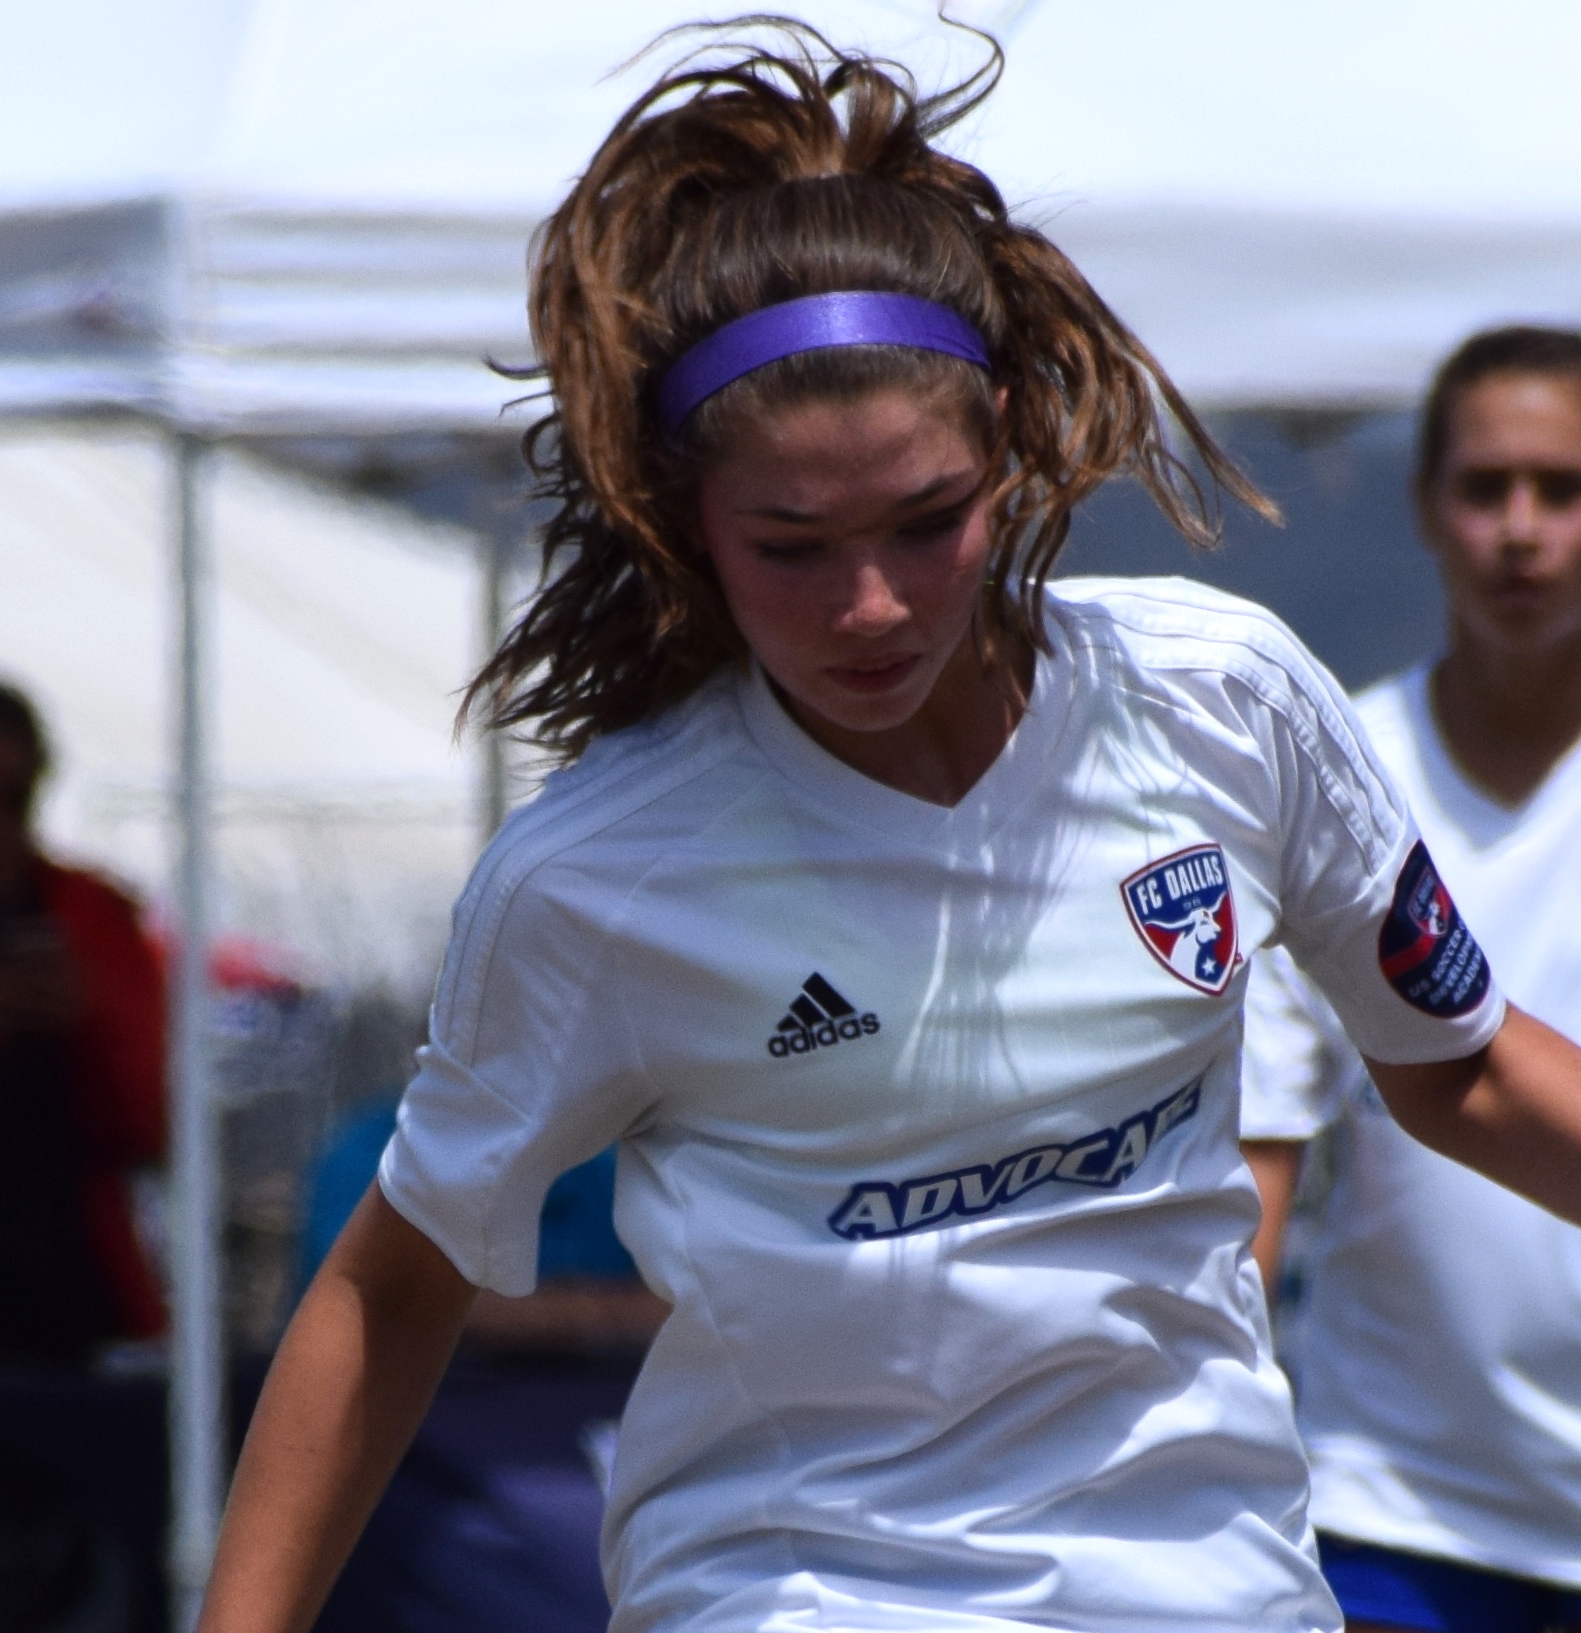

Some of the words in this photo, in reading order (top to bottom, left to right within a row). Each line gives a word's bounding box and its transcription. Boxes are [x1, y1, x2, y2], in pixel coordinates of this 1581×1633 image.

[1136, 877, 1163, 915] FC
[1164, 855, 1223, 900] DALLAS
[767, 1012, 880, 1058] adidas
